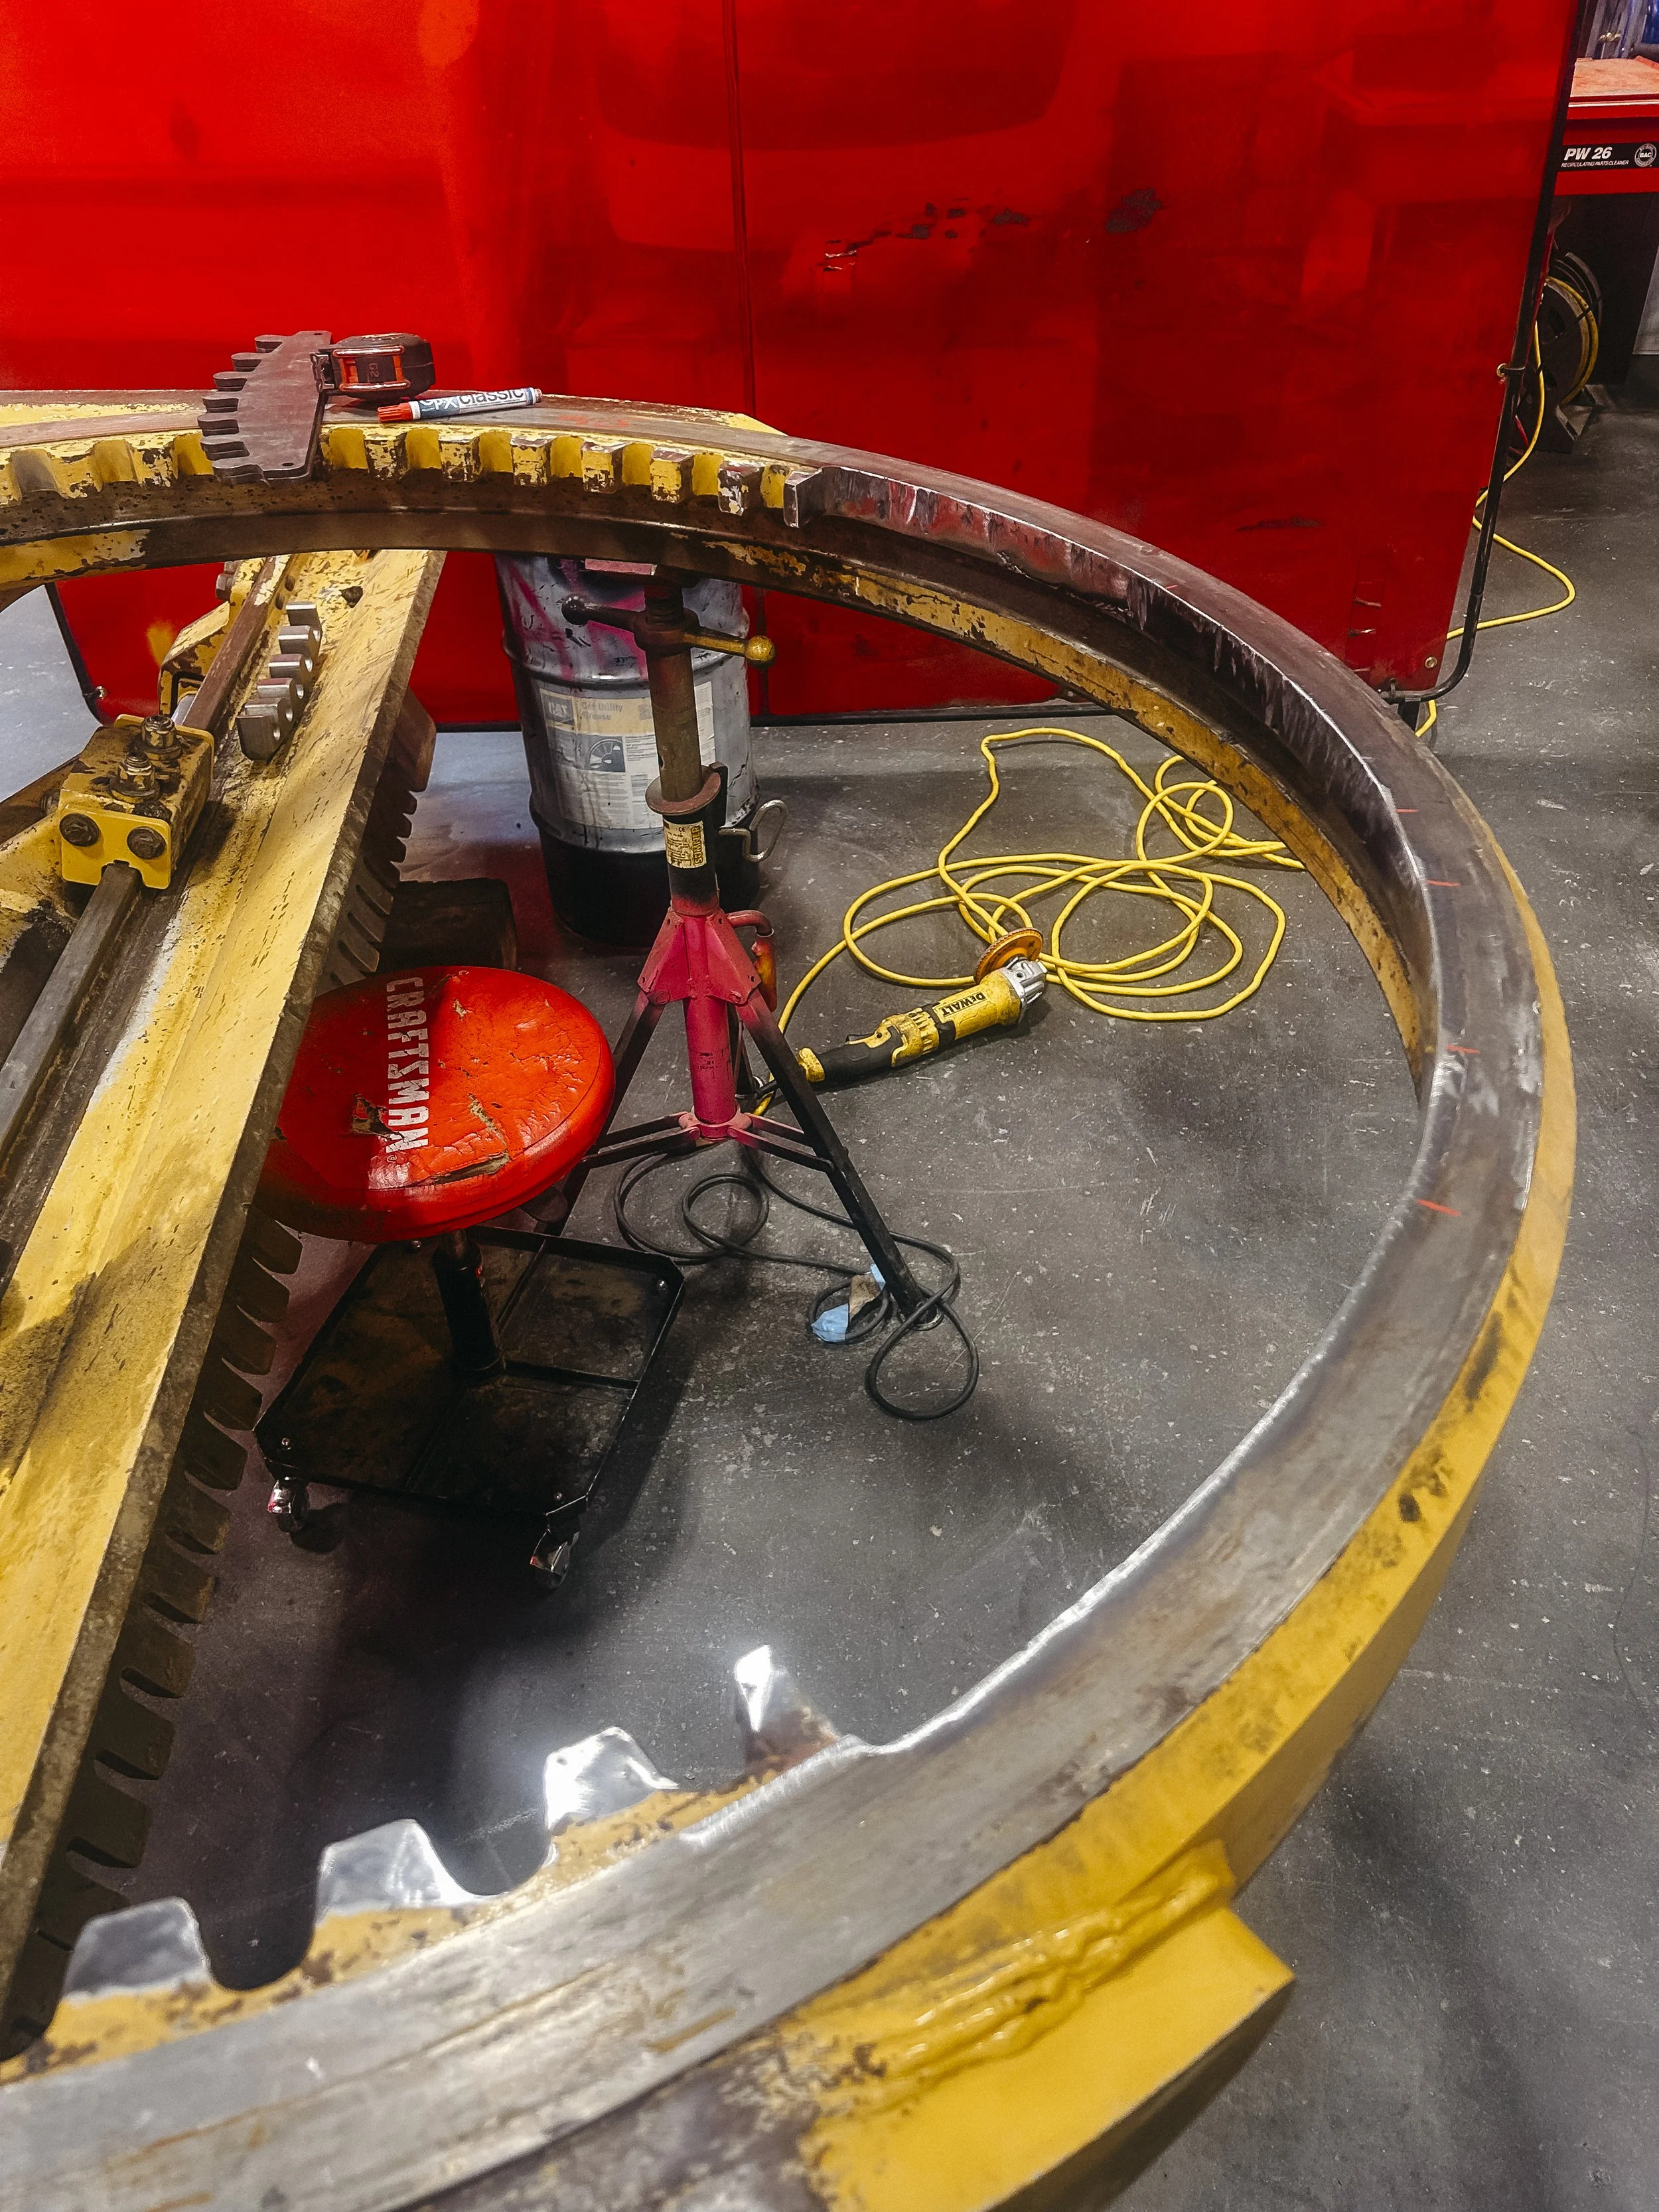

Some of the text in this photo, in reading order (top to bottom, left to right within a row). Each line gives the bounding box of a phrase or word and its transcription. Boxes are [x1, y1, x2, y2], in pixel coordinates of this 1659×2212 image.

[1563, 146, 1613, 161] PW 26
[598, 701, 622, 713] Utility
[386, 976, 429, 1153] CRAFTSMAN
